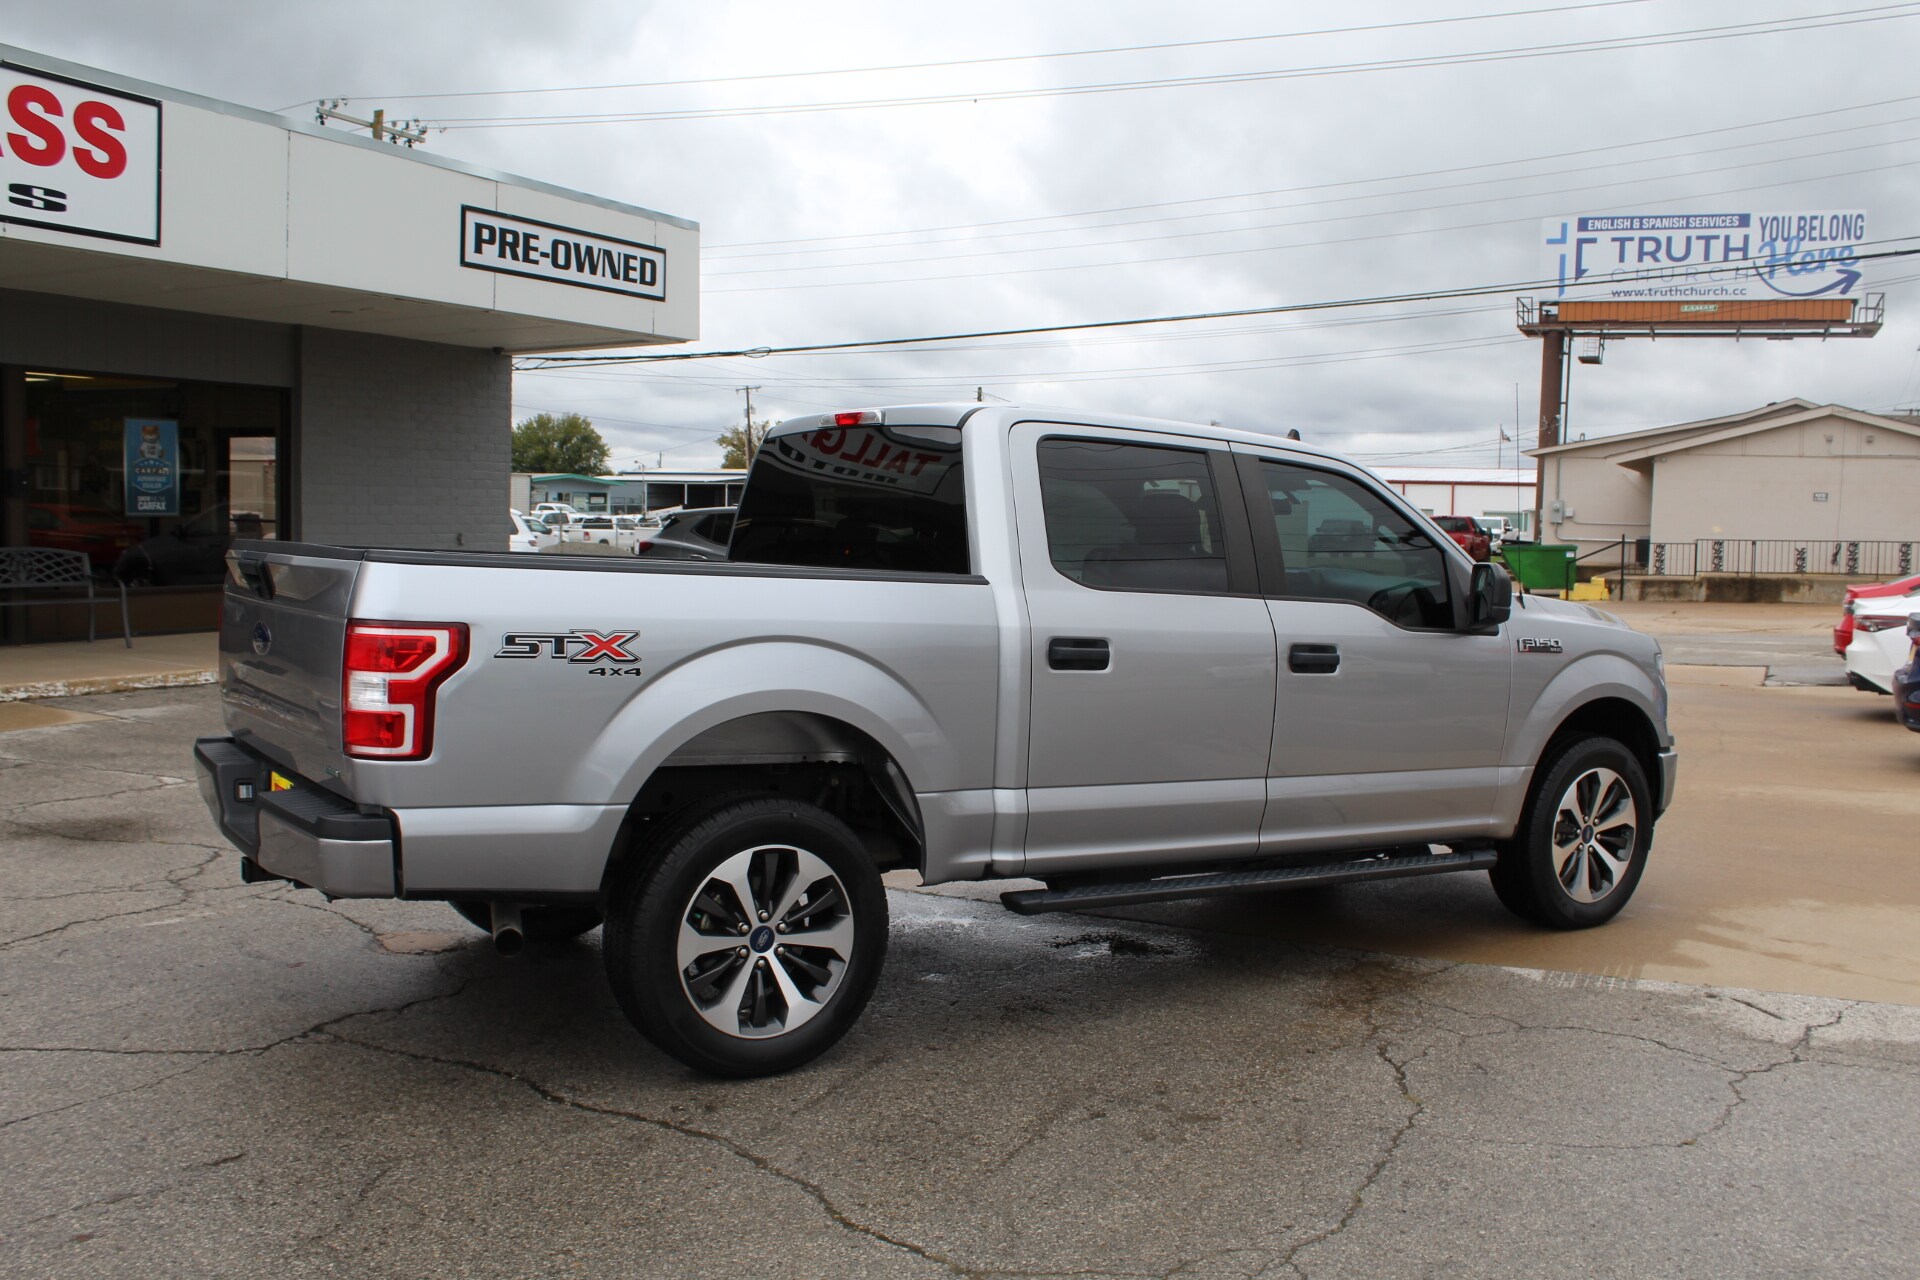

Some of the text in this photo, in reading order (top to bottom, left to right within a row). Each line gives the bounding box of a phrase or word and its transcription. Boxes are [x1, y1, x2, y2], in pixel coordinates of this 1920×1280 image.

[0, 85, 127, 179] SS
[1588, 215, 1740, 230] ENGLISH & SPANISH SERVICES
[1759, 213, 1865, 242] YOU BELONG
[473, 222, 657, 286] PRE-OWNED
[1611, 234, 1750, 263] TRUTH
[1758, 235, 1860, 279] Here
[1611, 265, 1749, 283] CHURCH
[1611, 286, 1747, 298] www.truthchurch.cc
[137, 501, 166, 511] CARFAX
[494, 629, 642, 664] STX
